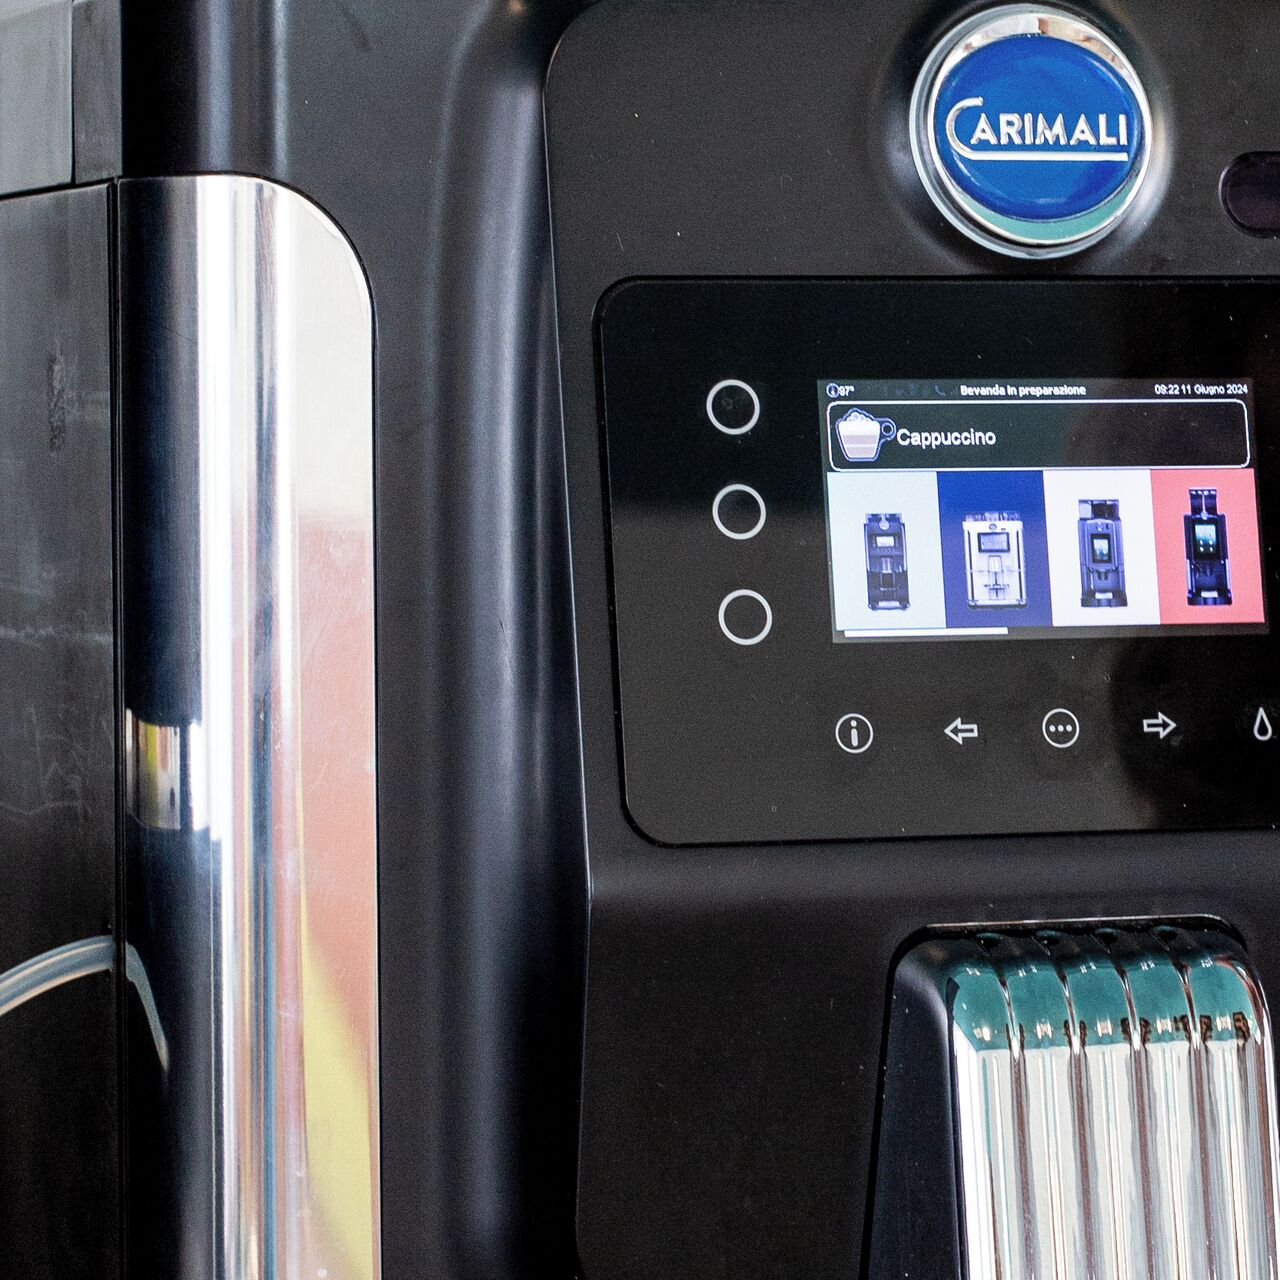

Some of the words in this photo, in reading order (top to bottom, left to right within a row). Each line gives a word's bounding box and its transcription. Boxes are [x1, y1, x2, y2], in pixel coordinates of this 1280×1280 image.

[946, 97, 1129, 161] CARIMALI
[960, 384, 1005, 396] Bevanda
[1007, 384, 1017, 395] in
[1019, 384, 1087, 397] preparazione
[1181, 384, 1191, 394] 11
[1194, 384, 1225, 396] Giugno
[1226, 384, 1248, 394] 2024
[896, 428, 997, 449] Cappuccino
